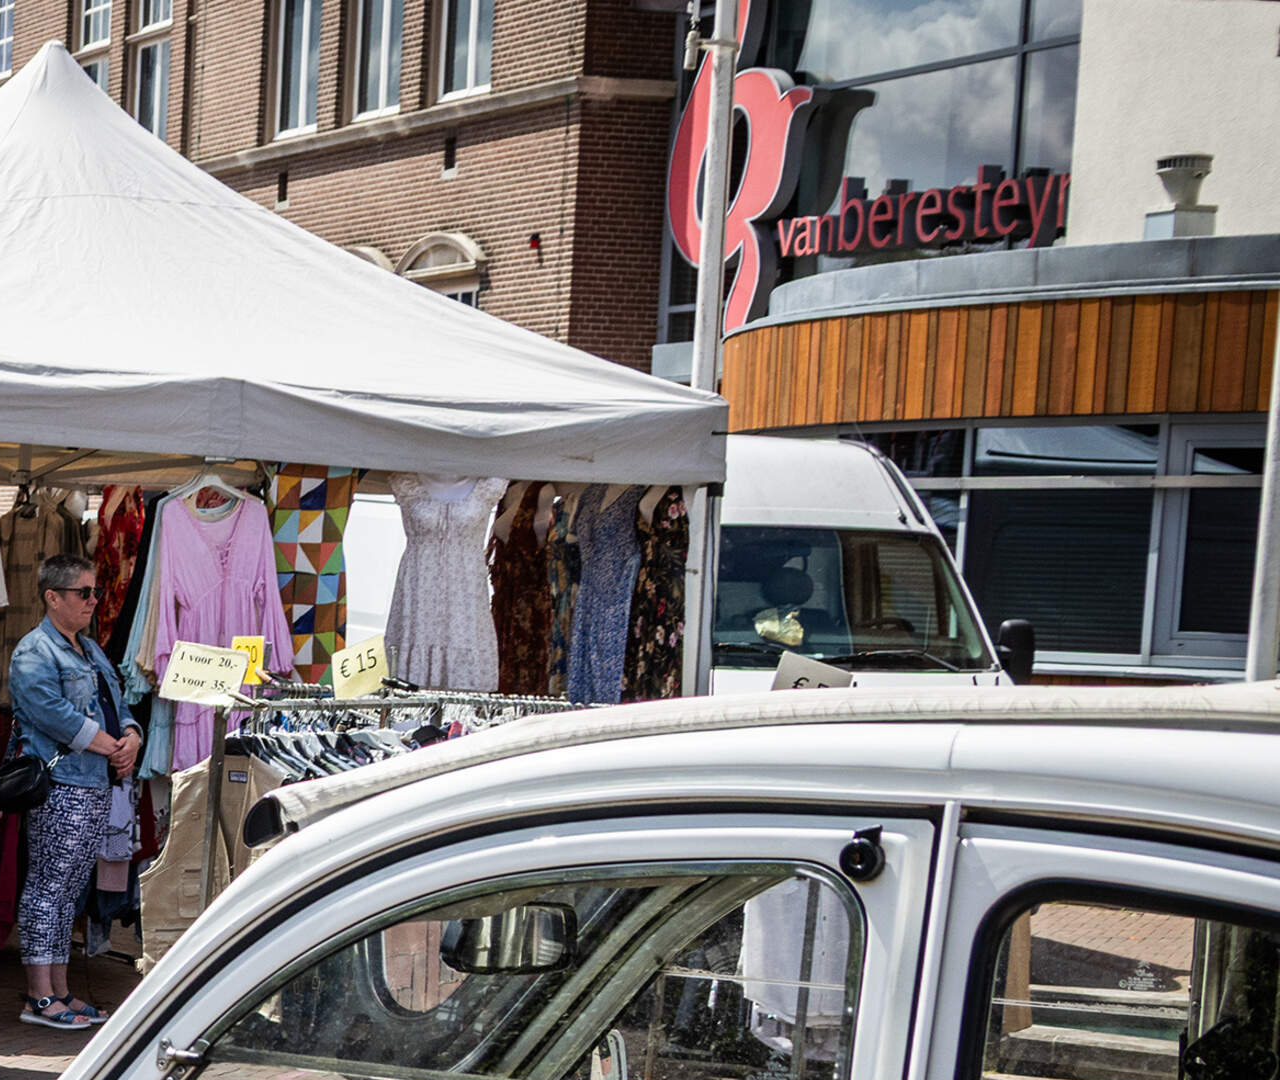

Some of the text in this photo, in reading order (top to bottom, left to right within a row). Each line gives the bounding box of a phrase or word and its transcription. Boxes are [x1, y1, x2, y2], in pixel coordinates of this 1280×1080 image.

[189, 655, 213, 665] voor
[341, 648, 377, 678] € 15
[172, 673, 180, 683] 2
[182, 677, 206, 688] voor
